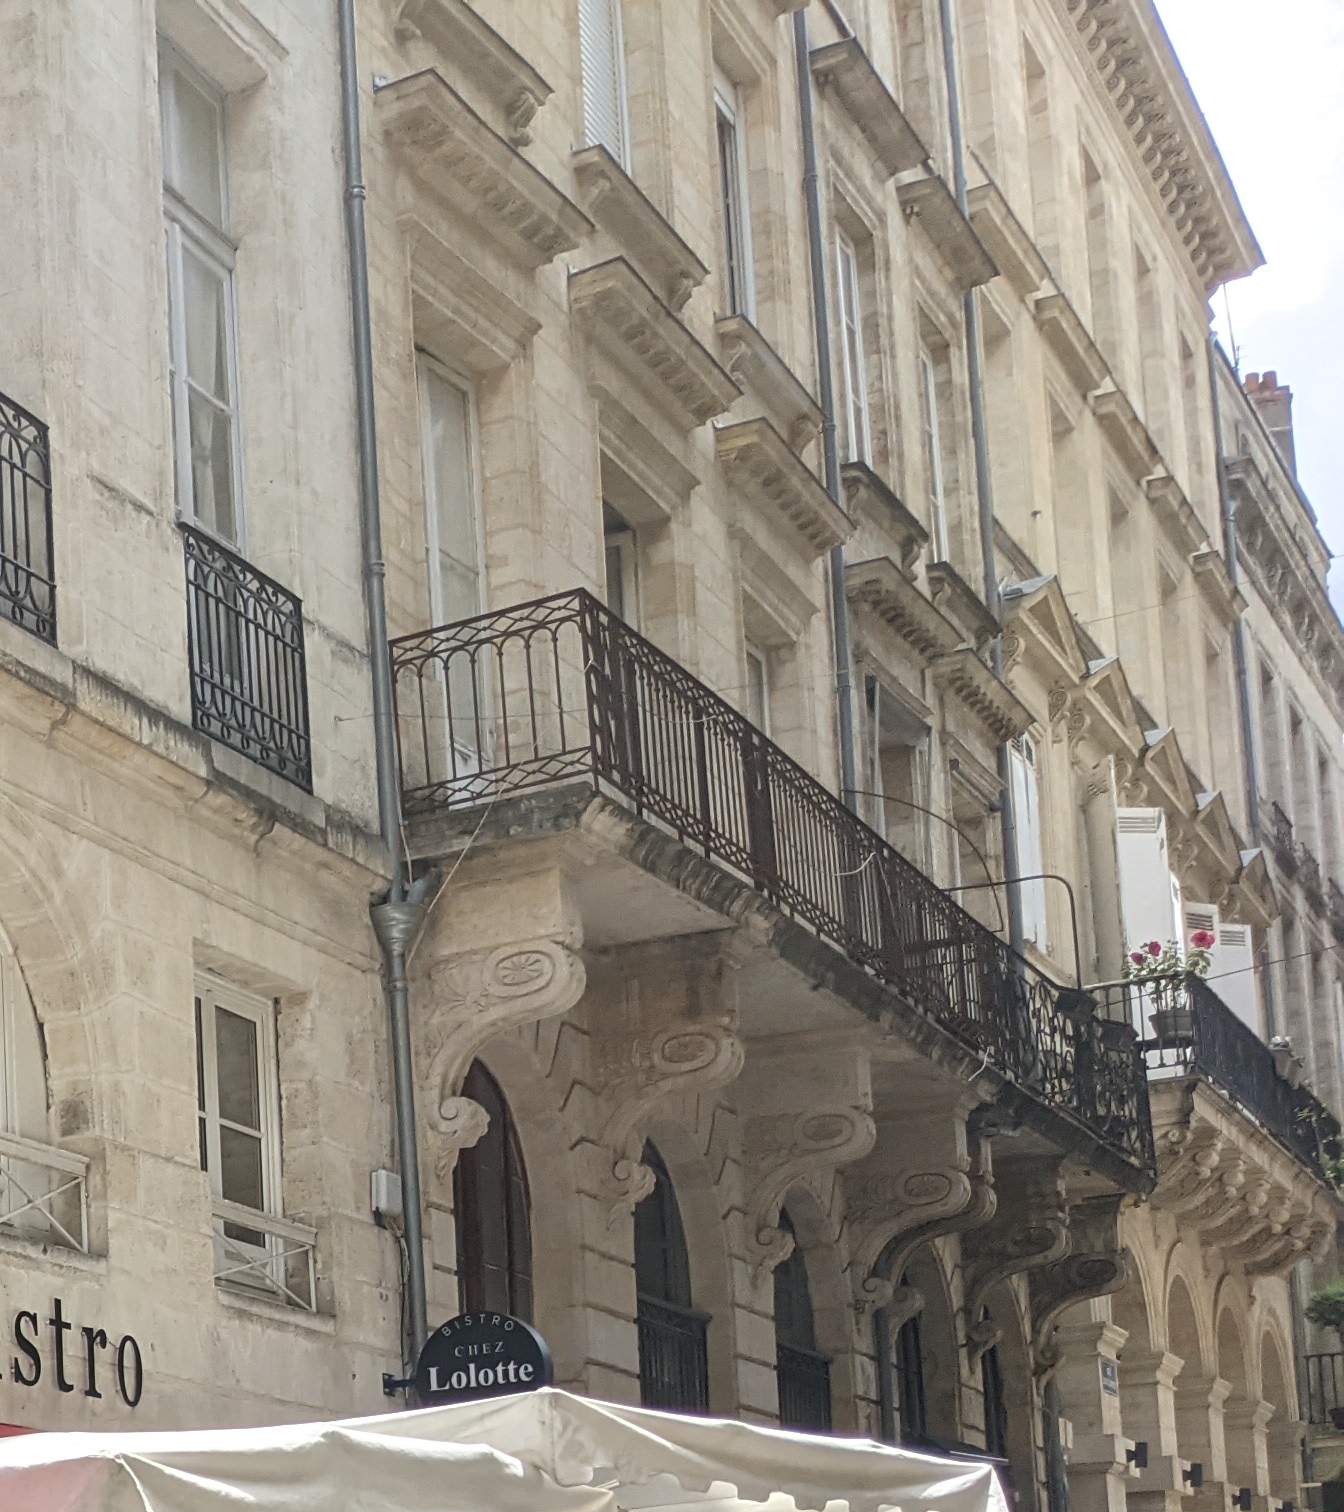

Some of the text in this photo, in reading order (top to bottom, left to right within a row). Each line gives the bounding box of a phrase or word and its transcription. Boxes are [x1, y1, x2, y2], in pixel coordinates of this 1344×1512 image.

[441, 1313, 515, 1338] BISTRO
[454, 1341, 505, 1358] CHEZ
[427, 1359, 535, 1393] Lolotte
